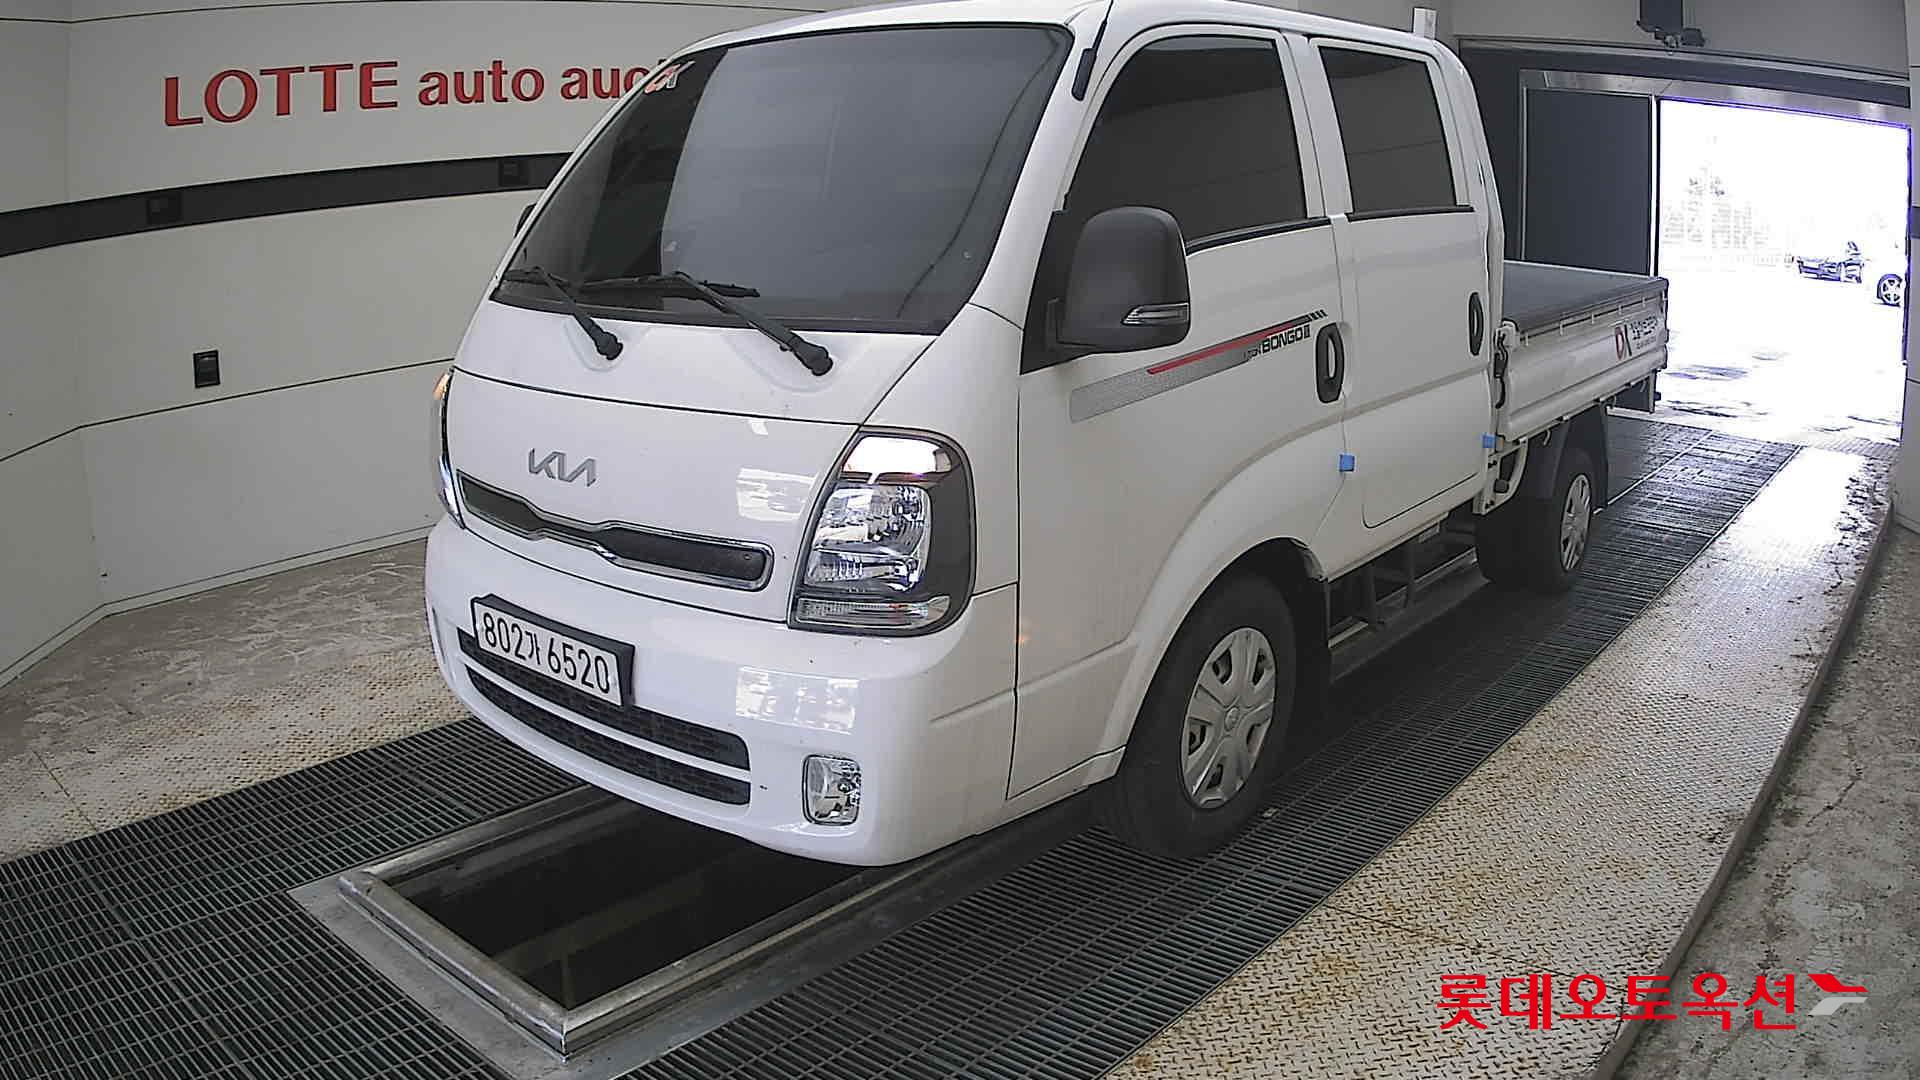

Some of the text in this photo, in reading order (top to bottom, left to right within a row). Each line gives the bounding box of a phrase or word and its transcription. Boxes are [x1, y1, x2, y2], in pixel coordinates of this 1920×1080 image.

[164, 61, 399, 127] LOTTE
[417, 59, 546, 106] auto
[528, 448, 596, 487] KIA
[547, 637, 610, 694] 6520
